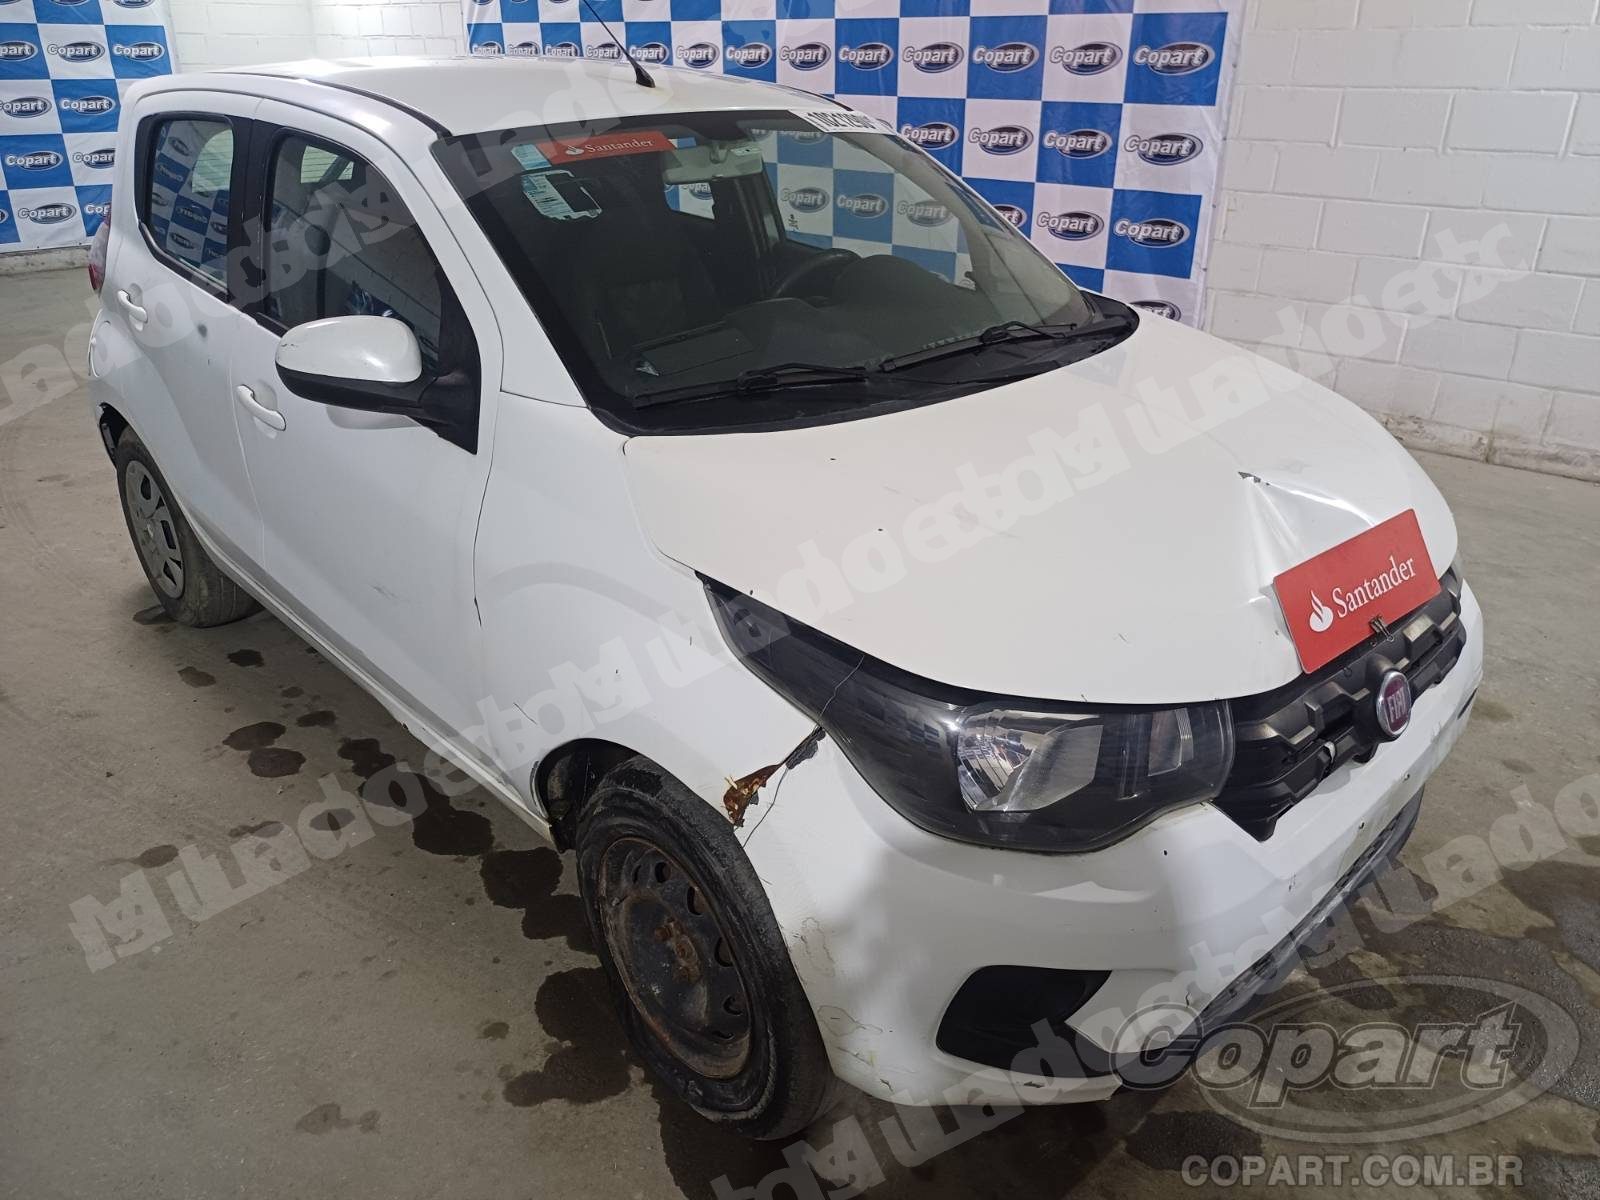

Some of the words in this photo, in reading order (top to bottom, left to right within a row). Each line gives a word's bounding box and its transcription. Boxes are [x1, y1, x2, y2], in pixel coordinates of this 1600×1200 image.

[47, 43, 97, 58] Copart
[113, 44, 160, 58] Copart
[545, 44, 576, 57] Copart
[586, 45, 618, 59] Copart
[628, 46, 664, 62] Copart
[676, 46, 714, 64] Copart
[725, 46, 767, 65] Copart
[780, 46, 823, 65] Copart
[839, 47, 886, 65] Copart
[903, 46, 955, 66] Copart
[973, 46, 1031, 69] Copart
[1050, 46, 1112, 69] Copart
[1134, 45, 1204, 69] Copart
[61, 98, 110, 113] Copart
[901, 123, 951, 145] Copart
[969, 127, 1024, 149] Copart
[1044, 131, 1105, 154] Copart
[585, 138, 654, 153] Santander
[1124, 134, 1192, 158] Copart
[6, 152, 58, 168] Copart
[73, 151, 116, 165] Copar
[781, 188, 823, 207] Copart
[837, 194, 882, 215] Copart
[18, 205, 70, 221] Copart
[897, 201, 947, 221] Copart
[1037, 211, 1095, 234] Copart
[1114, 218, 1180, 243] Copart
[1331, 555, 1417, 619] Santander
[1386, 686, 1407, 724] FIAT
